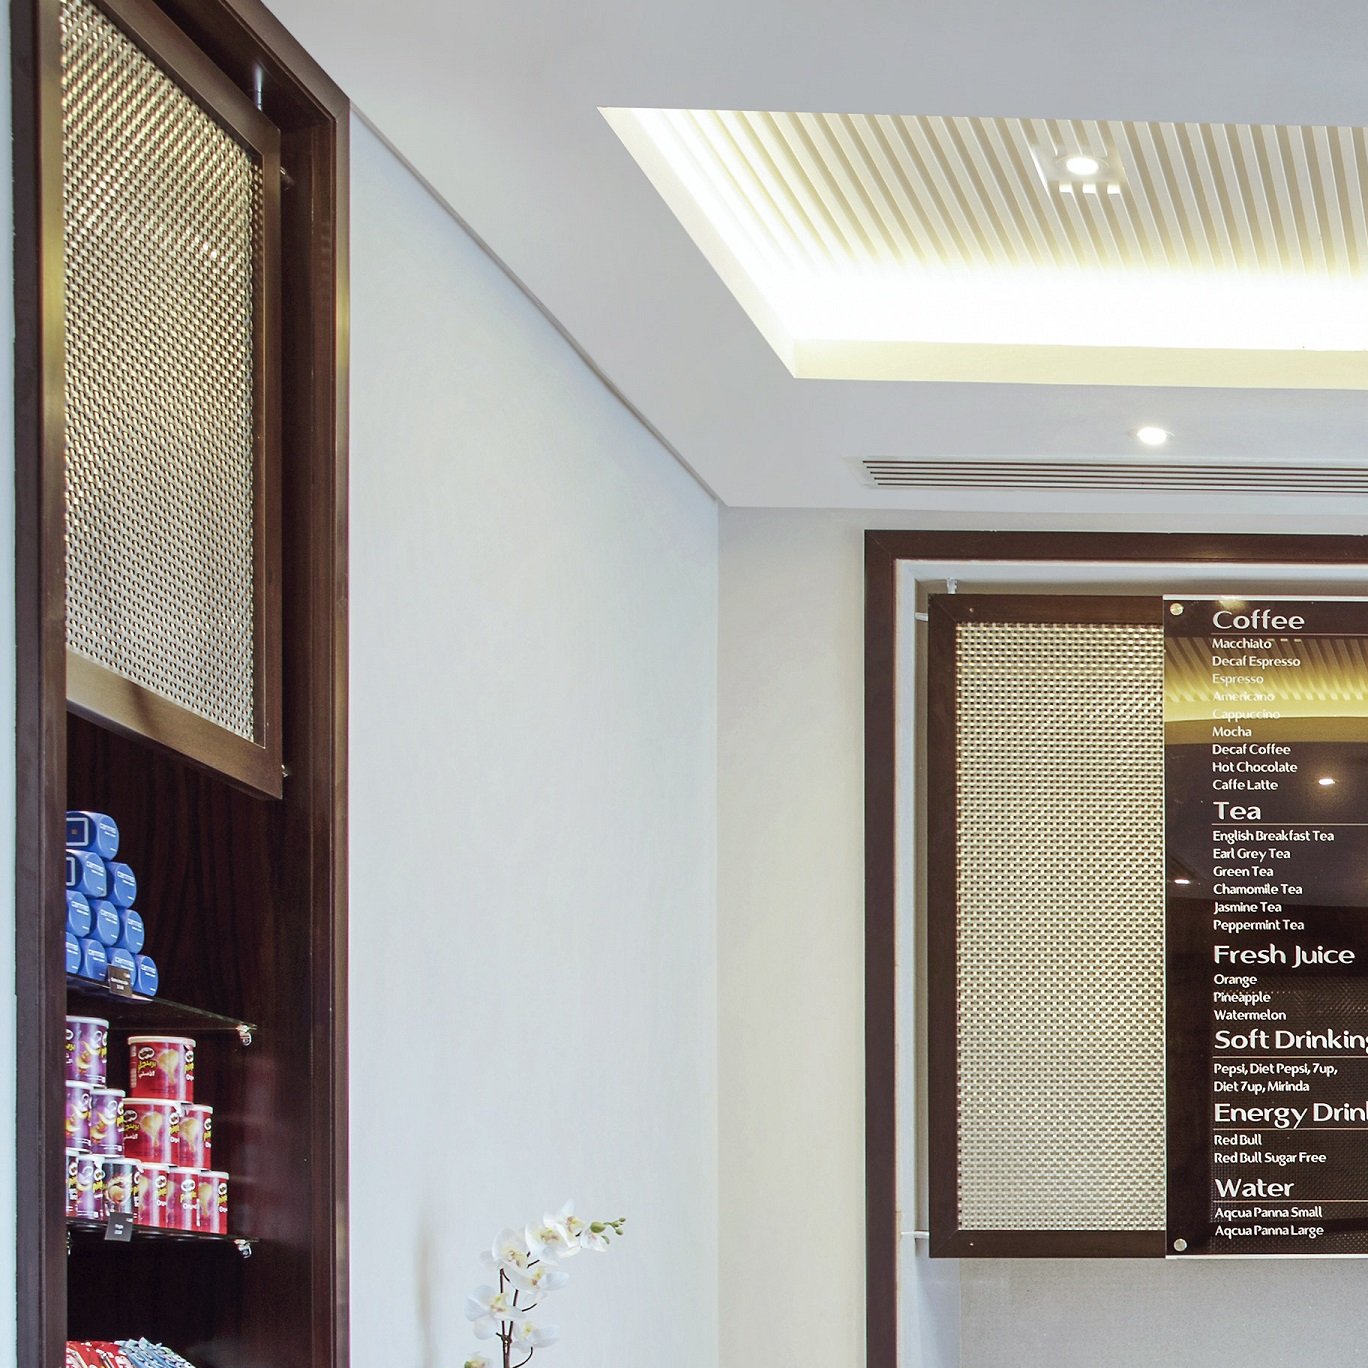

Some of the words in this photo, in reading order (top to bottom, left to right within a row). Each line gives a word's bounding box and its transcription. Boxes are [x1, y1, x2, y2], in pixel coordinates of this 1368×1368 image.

[1212, 610, 1304, 630] Coffee
[1212, 638, 1272, 650] Macchiato
[1212, 727, 1252, 737] Mocha
[1212, 763, 1234, 772] Hot
[1236, 762, 1298, 772] Chocolate
[1212, 780, 1245, 790] Caffe
[1248, 781, 1278, 790] Latte
[1213, 802, 1261, 820] Tea
[1213, 830, 1254, 844] English
[1256, 831, 1310, 841] Breakfast
[1312, 832, 1334, 841] Tea
[1214, 920, 1280, 933] Peppermint
[1283, 920, 1304, 930] Tea
[1214, 944, 1286, 964] Fresh
[1292, 946, 1355, 968] Juice
[1214, 1010, 1286, 1020] Watermelon
[1215, 1029, 1269, 1049] Soft
[1214, 1064, 1248, 1076] Pepsi,
[1250, 1064, 1274, 1074] Diet
[1277, 1064, 1310, 1076] Pepsi,
[1312, 1064, 1338, 1076] 7up,
[1214, 1082, 1238, 1092] Diet
[1241, 1082, 1266, 1094] 7up,
[1268, 1082, 1309, 1092] Mirinda
[1214, 1104, 1307, 1128] Energy
[1214, 1153, 1237, 1163] Red
[1240, 1152, 1262, 1163] Bull
[1264, 1153, 1296, 1166] Sugar
[1299, 1153, 1326, 1162] Free
[1215, 1178, 1294, 1197] Water
[1254, 1226, 1289, 1235] Panna
[1291, 1226, 1324, 1238] Large
